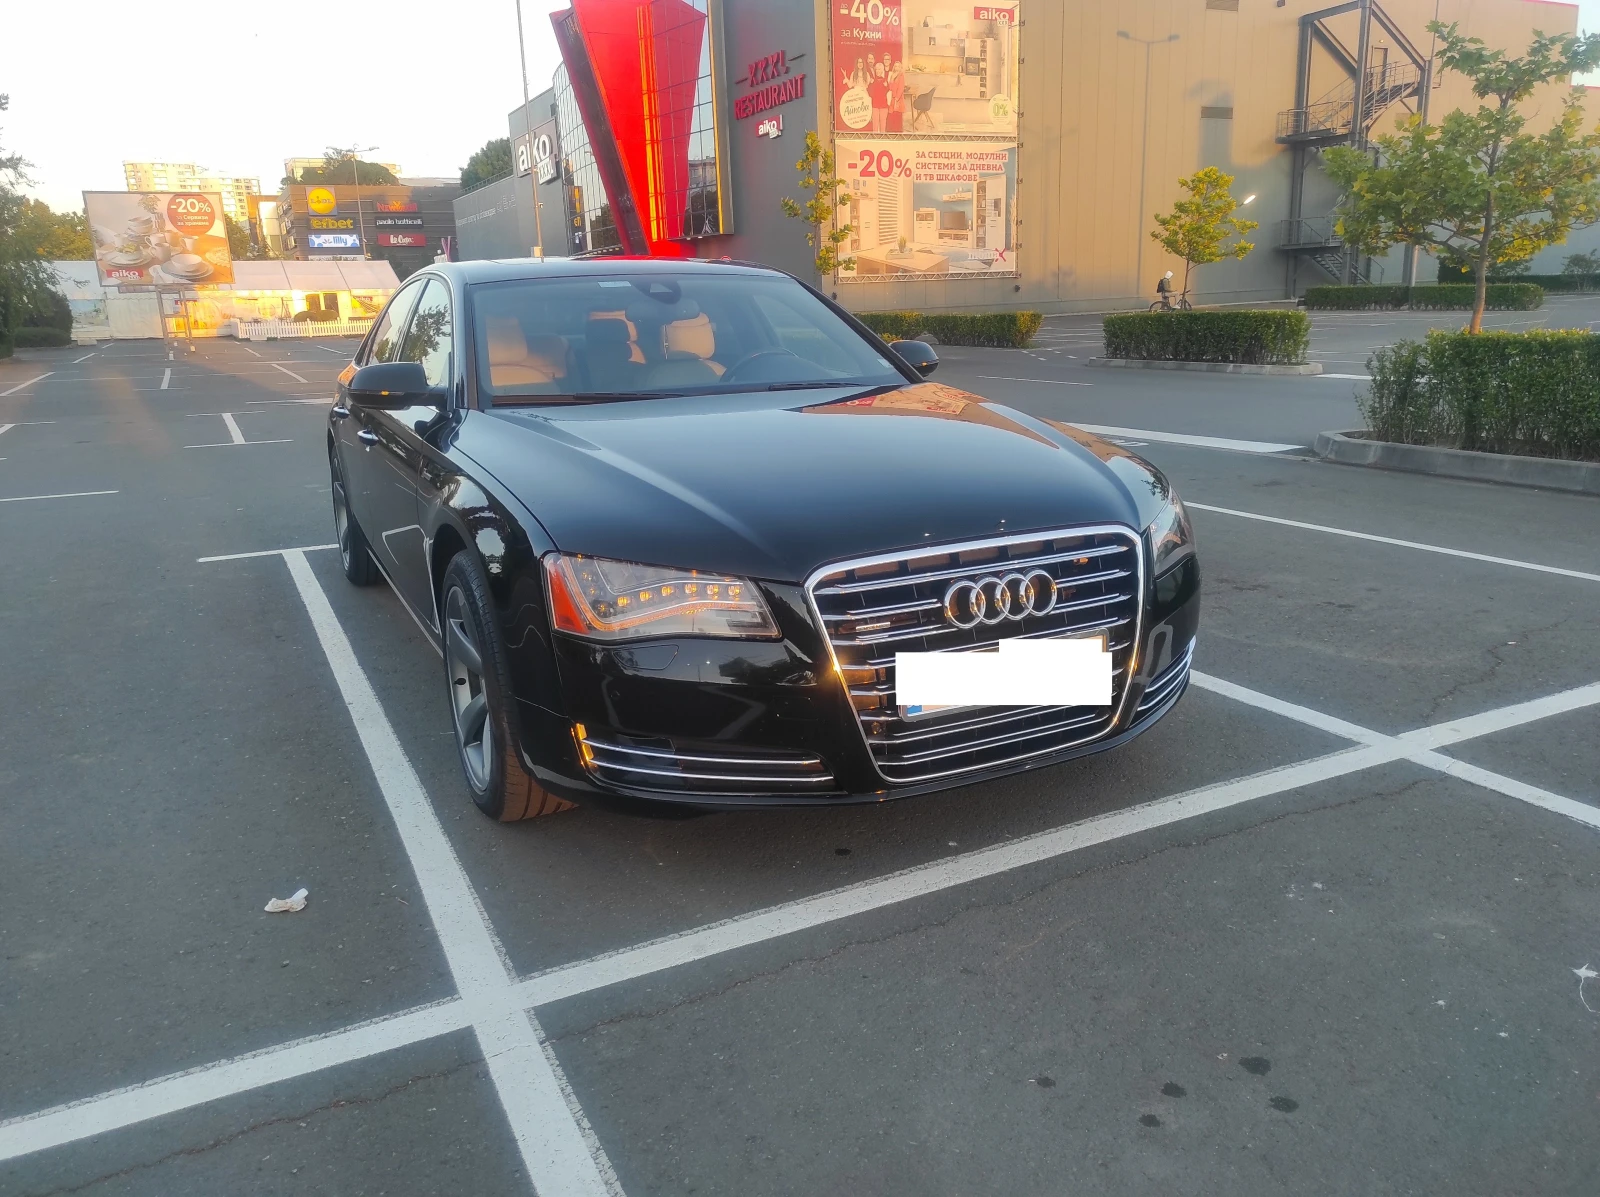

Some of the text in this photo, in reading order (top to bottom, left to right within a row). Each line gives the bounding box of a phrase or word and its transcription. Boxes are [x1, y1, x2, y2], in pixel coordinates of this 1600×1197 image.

[839, 0, 900, 26] -40%
[979, 8, 1010, 20] aiko
[840, 27, 882, 41] за Кухни
[734, 73, 806, 120] RESTAURANT
[758, 119, 778, 135] aiko
[518, 132, 550, 172] aiko
[915, 151, 1008, 162] ЗА СЕКЦИИ, МОДУЛНИ
[847, 149, 913, 178] -20%
[915, 162, 1004, 173] СИСТЕМИ ЗА ДНЕВНА
[915, 173, 922, 181] И
[935, 173, 978, 182] ШКАФОВЕ
[170, 198, 211, 213] -20%
[111, 269, 139, 278] aiko
